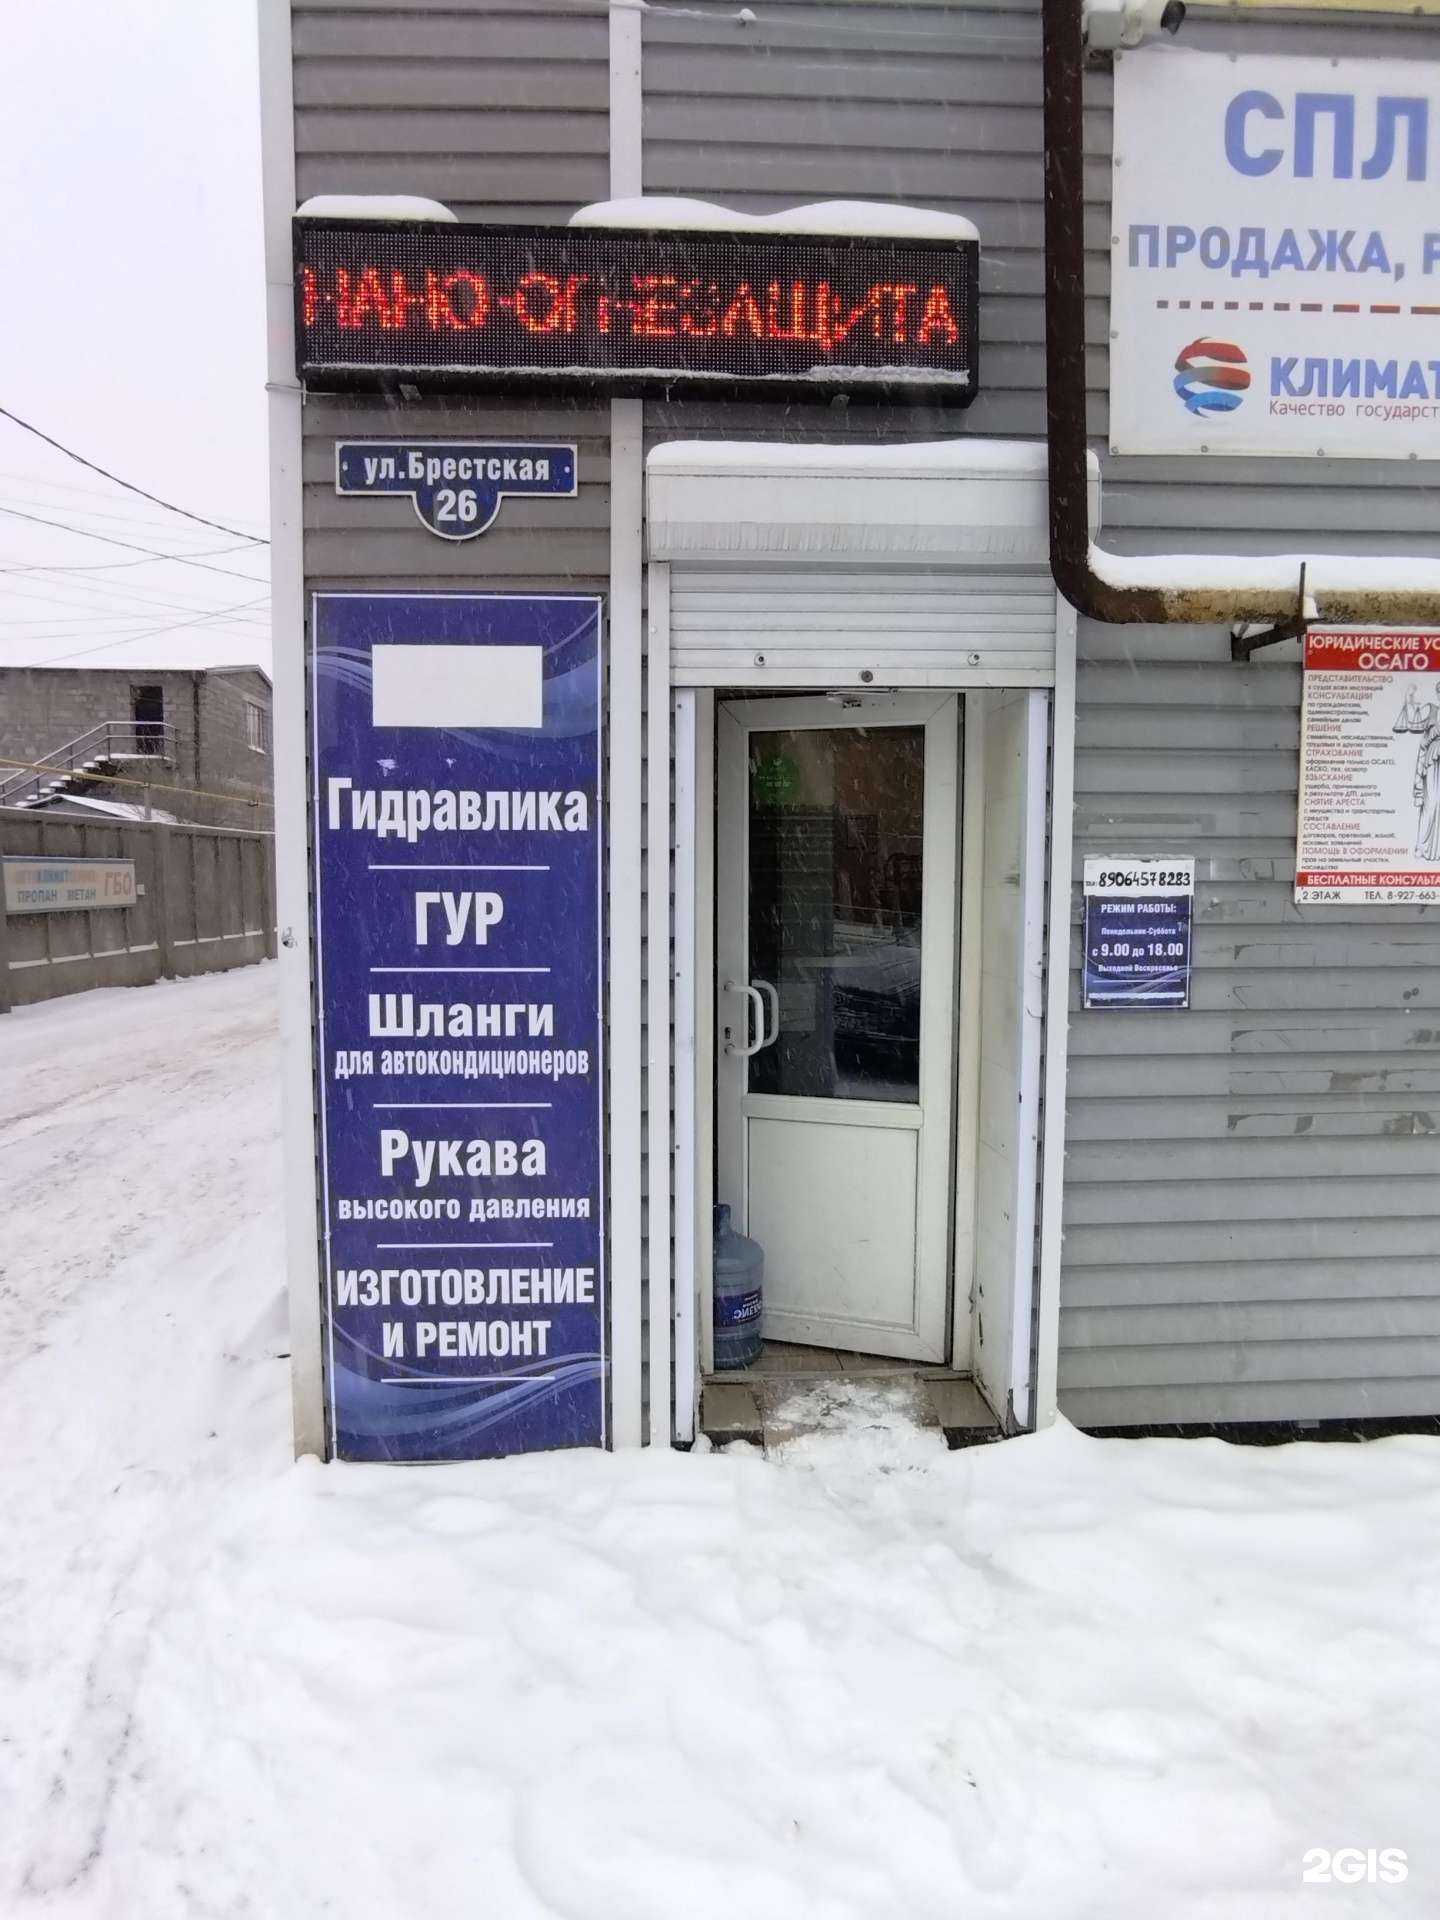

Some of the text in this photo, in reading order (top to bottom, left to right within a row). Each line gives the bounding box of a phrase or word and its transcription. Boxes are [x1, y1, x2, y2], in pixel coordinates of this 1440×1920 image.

[1224, 90, 1430, 181] СПЛ
[1128, 224, 1405, 284] ПРОДАЖА,
[1269, 400, 1345, 417] Качество
[364, 452, 549, 486] ул.Брестская
[436, 489, 477, 521] 26
[1309, 635, 1419, 651] ЮРИДИЧЕСКИЕ
[1358, 653, 1429, 670] ОСАГО
[328, 777, 588, 842] Гидравлика
[1099, 872, 1190, 887] 89064578283
[1307, 875, 1377, 885] БЕСПЛАТНЫЕ
[1101, 904, 1176, 913] РЕЖИМ РАБОТЫ:
[1303, 891, 1308, 900] 2
[1312, 891, 1341, 900] ЭТАЖ
[1365, 891, 1384, 900] ТЕЛ.
[415, 891, 504, 945] ГУР
[1101, 944, 1129, 956] 9.00
[1132, 948, 1144, 957] до
[1148, 943, 1183, 956] 18.00
[369, 994, 554, 1037] Шланги
[335, 1050, 588, 1081] для автокондиционеров
[380, 1129, 546, 1187] Рукава
[338, 1198, 590, 1222] высокого давления
[337, 1268, 594, 1306] ИЗГОТОВЛЕНИЕ
[383, 1320, 551, 1358] И РЕМОНТ
